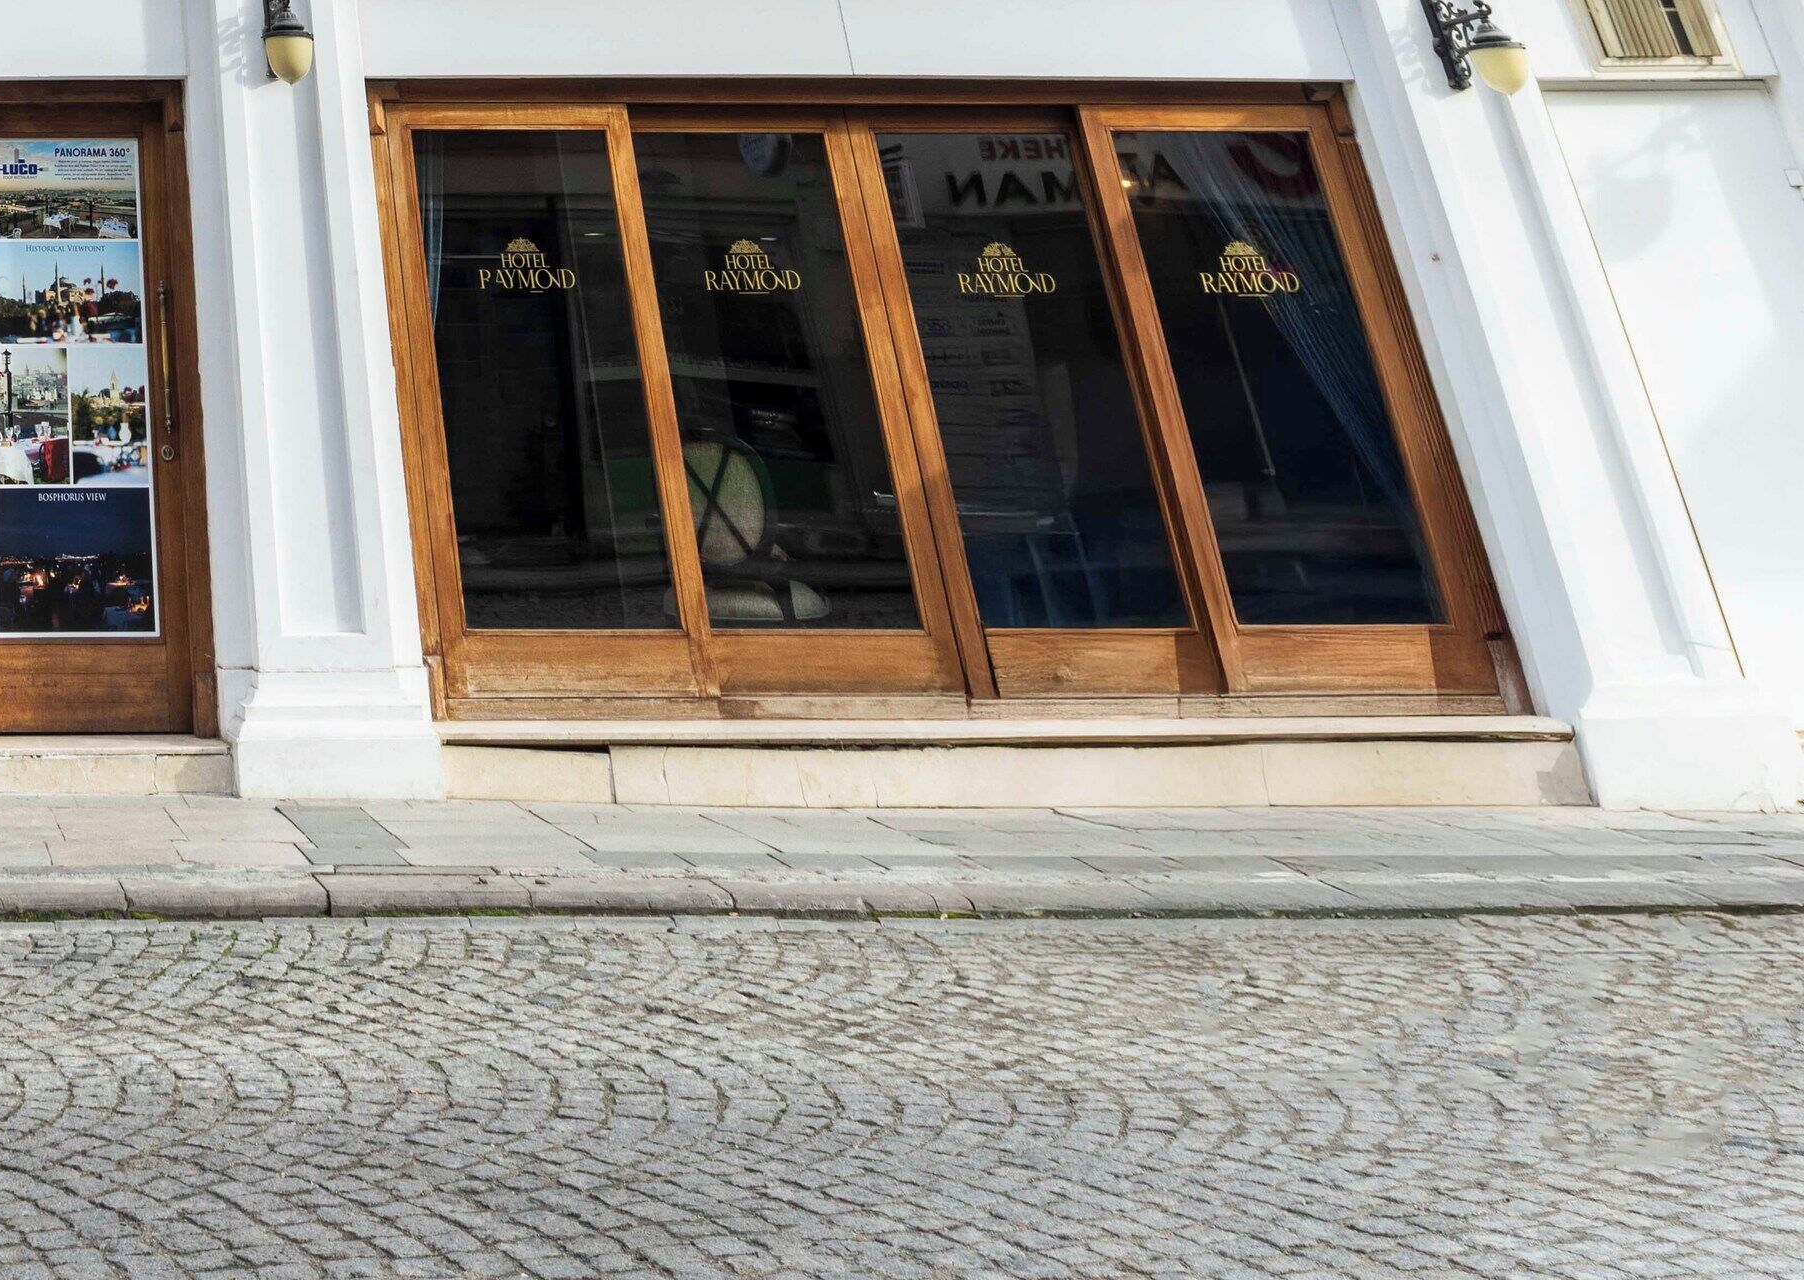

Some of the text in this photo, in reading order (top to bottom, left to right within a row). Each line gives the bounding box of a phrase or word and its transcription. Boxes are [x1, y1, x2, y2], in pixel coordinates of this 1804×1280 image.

[54, 148, 107, 157] PANORAMA
[2, 163, 38, 175] LUCO
[501, 253, 550, 269] HOTEL
[724, 254, 775, 270] HOTEL
[977, 257, 1029, 273] HOTEL
[1219, 257, 1272, 272] HOTEL
[704, 270, 801, 291] RAYMOND
[957, 273, 1056, 294] RAYMOND
[1200, 272, 1300, 293] RAYMOND
[38, 492, 106, 502] BOSPHORUS VIEW
